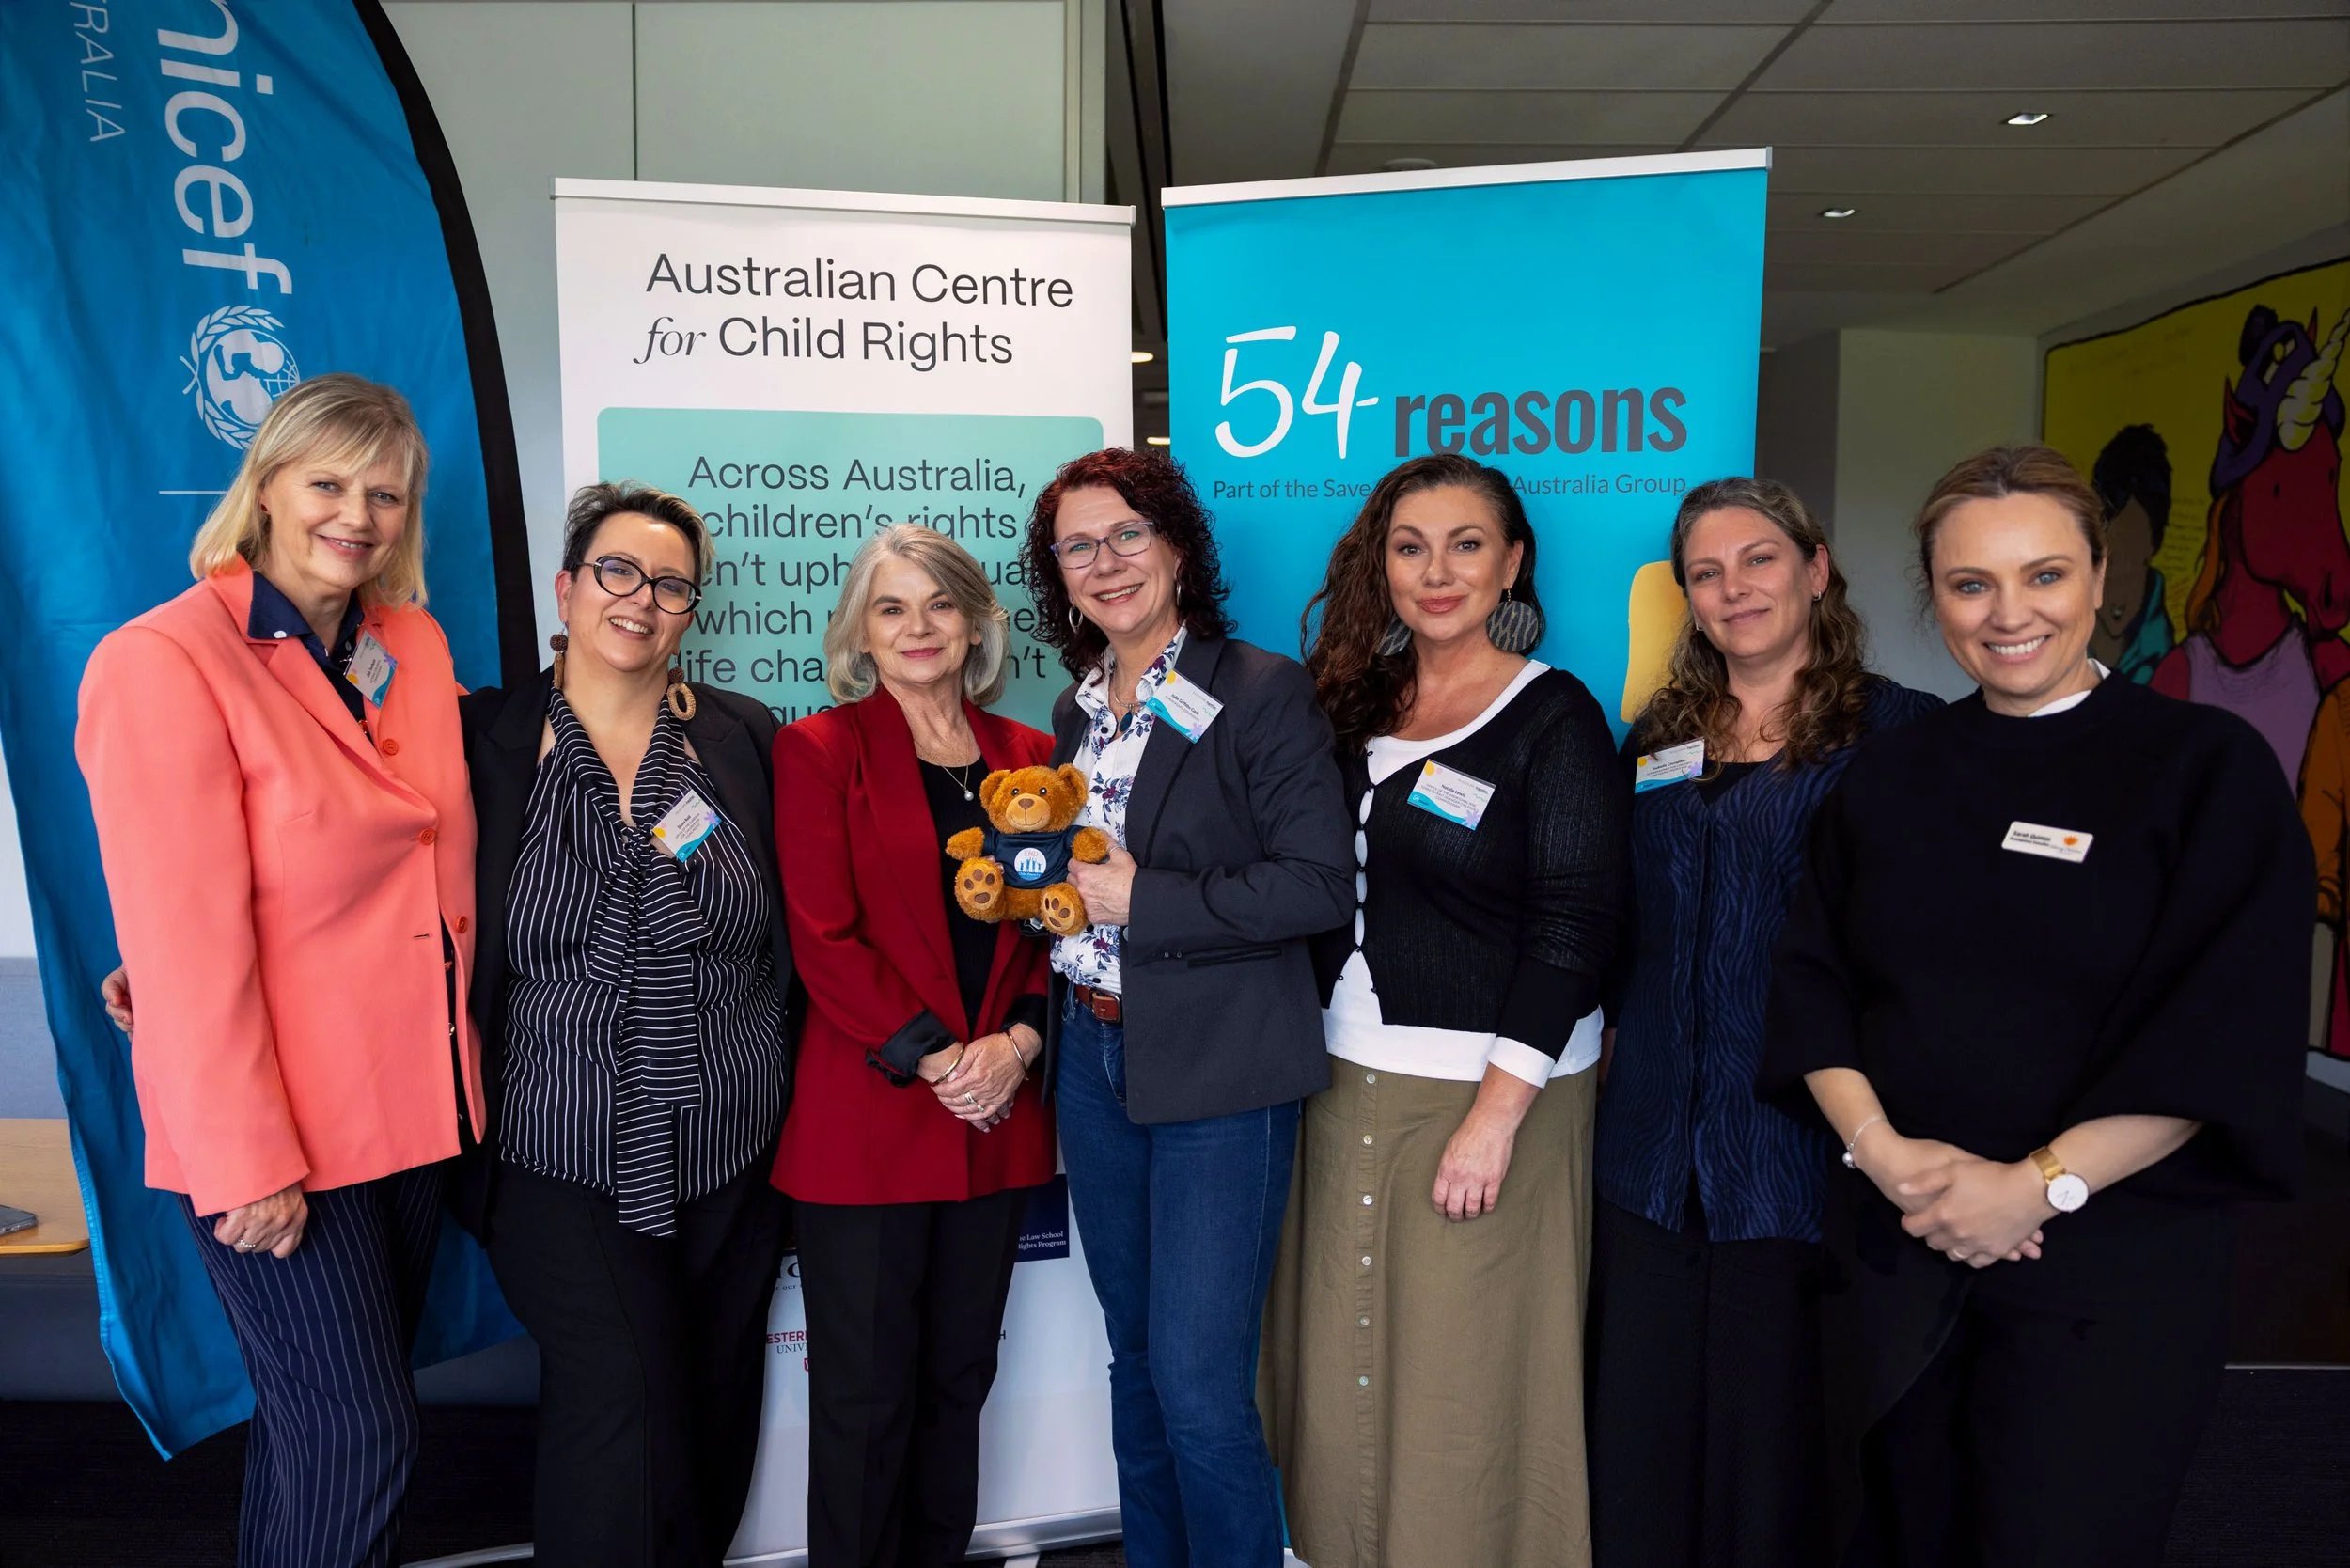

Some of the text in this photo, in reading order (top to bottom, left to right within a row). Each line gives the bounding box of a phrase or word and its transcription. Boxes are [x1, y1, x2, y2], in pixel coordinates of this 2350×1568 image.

[70, 0, 126, 142] RALIA
[157, 0, 292, 294] nicef
[646, 253, 1073, 307] Australian Centre
[633, 316, 1012, 372] for Child Rights
[1215, 326, 1687, 459] 54 reasons
[688, 456, 1025, 498] Across Australia,
[1214, 478, 1370, 498] Part of the Save
[1512, 474, 1686, 496] Australia Group
[780, 553, 852, 594] uph
[695, 601, 812, 635] which
[750, 650, 824, 682] cha
[1042, 1231, 1063, 1239] School
[766, 1330, 807, 1344] ESTER
[776, 1342, 807, 1355] UNIV
